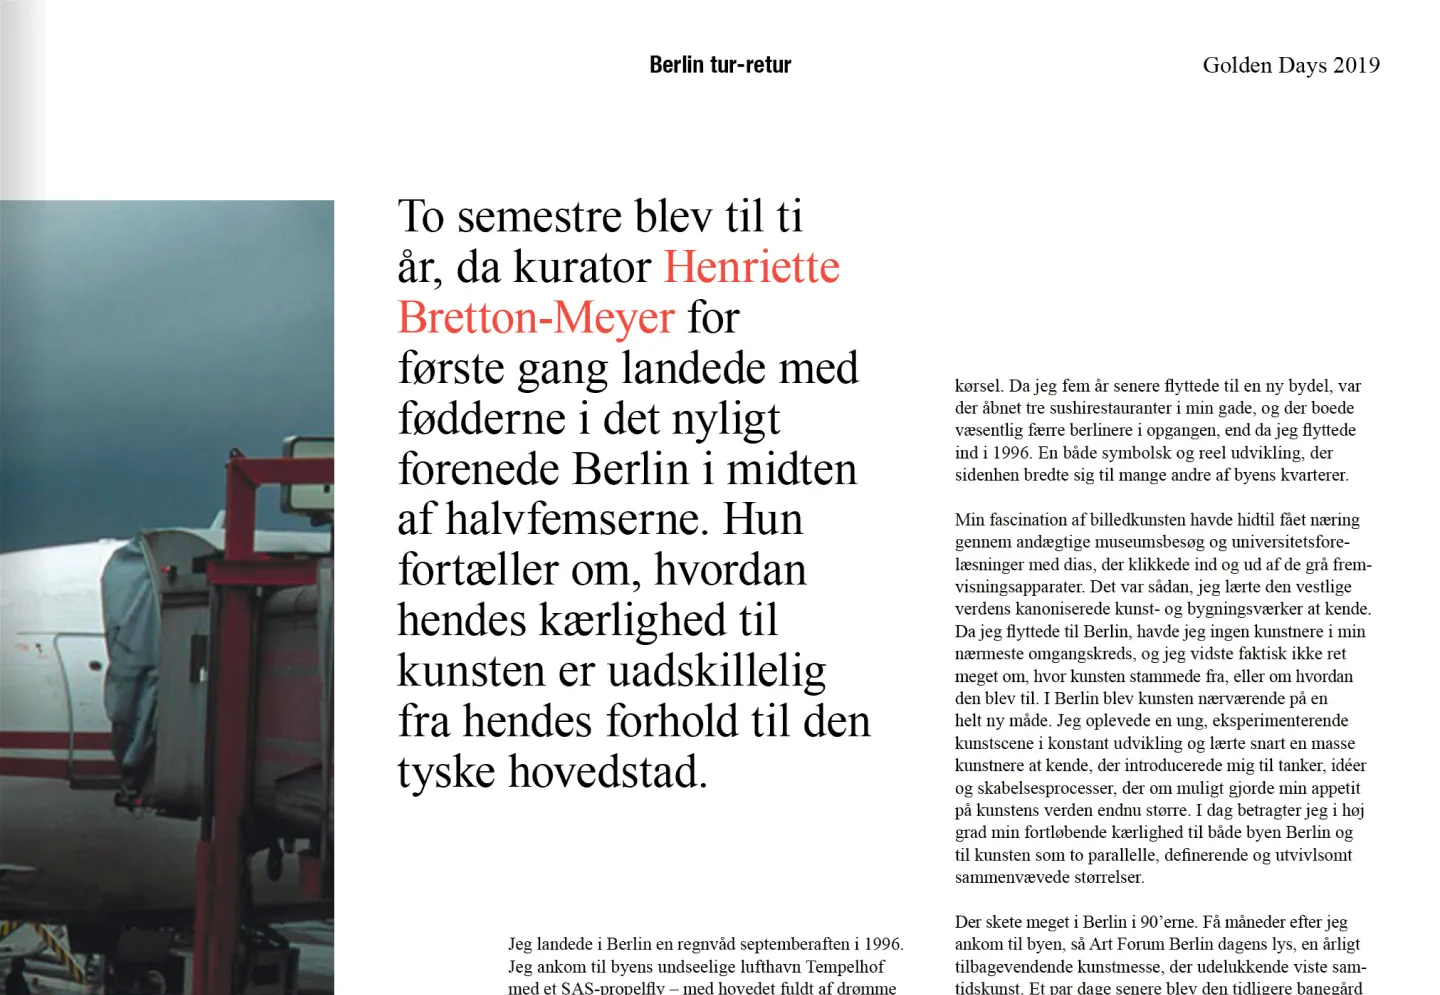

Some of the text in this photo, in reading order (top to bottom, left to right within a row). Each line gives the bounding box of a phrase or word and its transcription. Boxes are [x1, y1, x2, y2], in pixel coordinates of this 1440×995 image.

[650, 54, 793, 74] Berlin tur-retur
[1202, 55, 1381, 79] Golden Days 2019
[397, 197, 803, 233] To semestre blev til ti
[398, 247, 840, 291] år, da kurator Henriette
[398, 298, 741, 344] Bretton-Meyer for
[398, 348, 860, 394] første gang landede med
[398, 399, 782, 445] fødderne i det nyligt
[398, 449, 859, 486] forenede Berlin i midten
[397, 499, 805, 536] af halvfemserne. Hun
[954, 511, 1361, 530] Min fascination af billedkunsten havde hidtil fået næring
[398, 550, 808, 593] fortæller om, hvordan
[396, 600, 779, 646] hendes kærlighed til
[396, 651, 827, 697] kunsten er uadskillelig
[398, 701, 872, 738] fra hendes forhold til den
[396, 752, 707, 798] tyske hovedstad.
[507, 936, 904, 955] Jeg landede i Berlin en regnvåd septemberaften i 1996.
